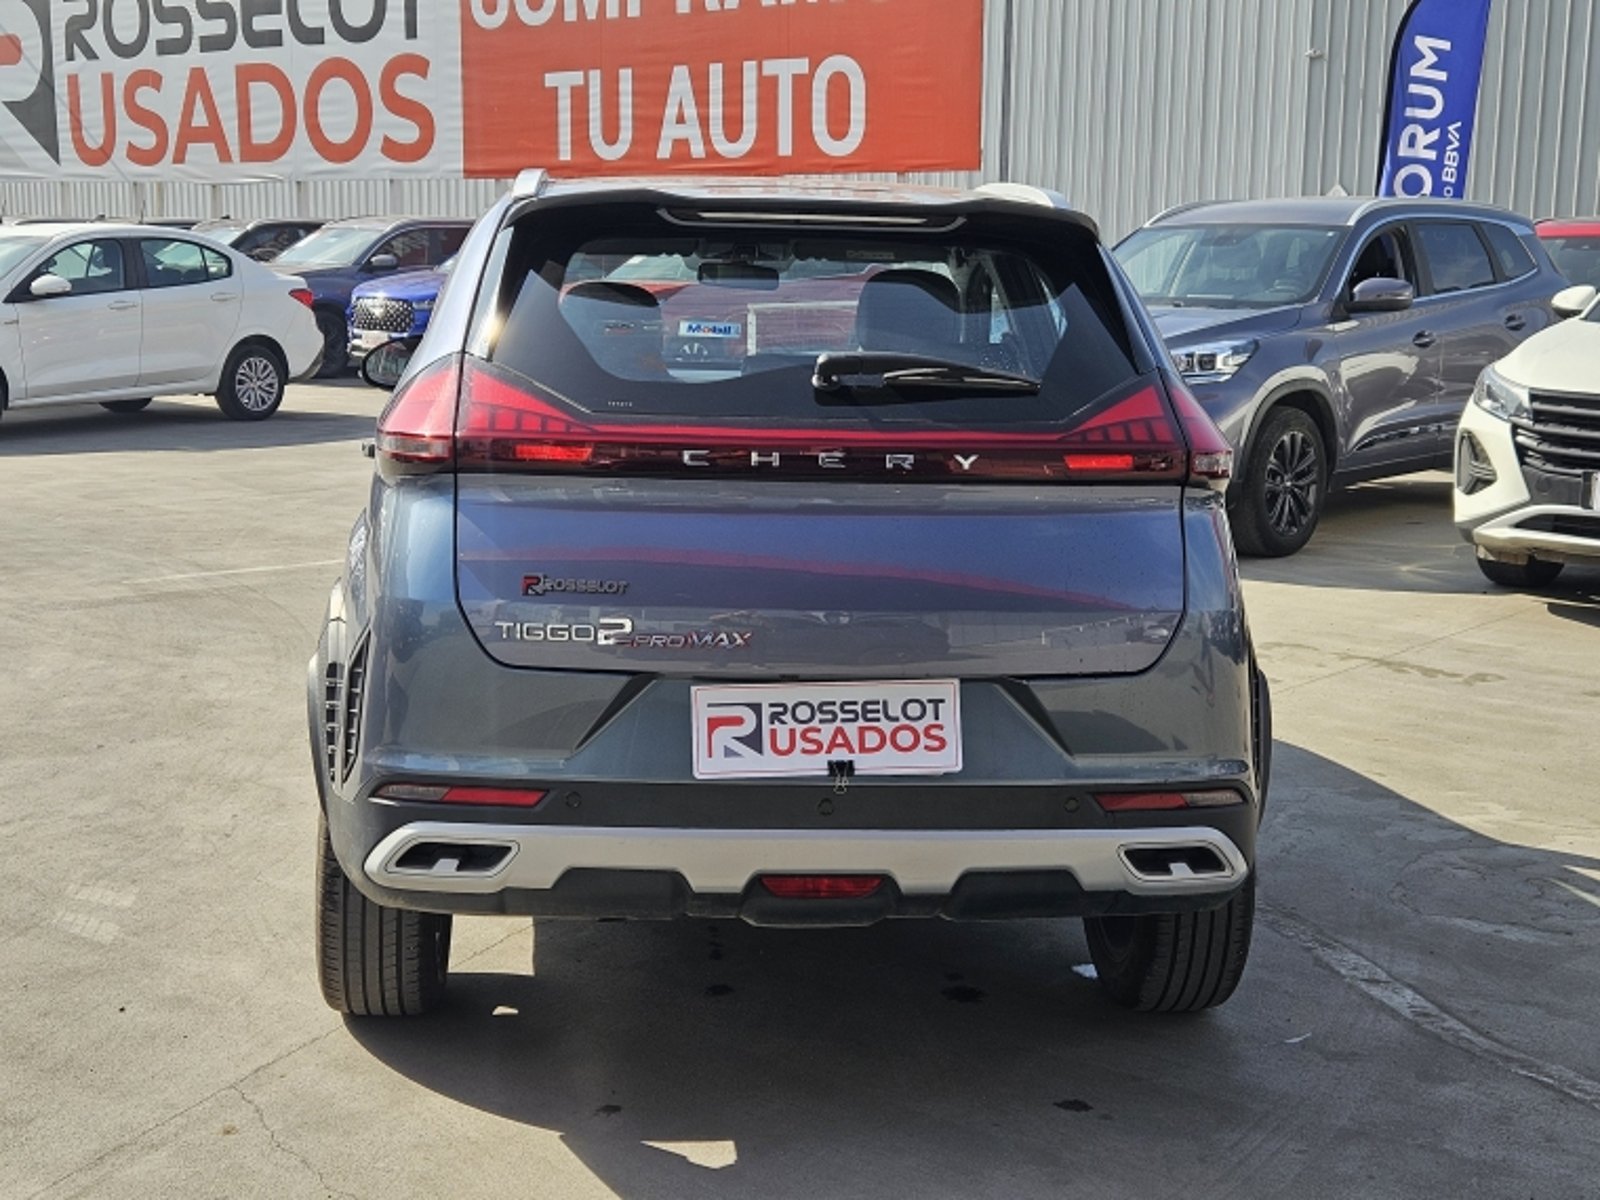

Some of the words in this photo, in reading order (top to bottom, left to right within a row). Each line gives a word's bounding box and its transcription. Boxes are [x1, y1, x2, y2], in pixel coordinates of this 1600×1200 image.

[67, 52, 436, 167] USADOS
[544, 68, 633, 161] TU
[656, 54, 866, 159] AUTO
[1442, 121, 1462, 183] BBVA
[687, 323, 732, 335] Mobil
[682, 450, 979, 470] CHERY
[544, 578, 627, 594] ROSSELOT
[495, 621, 594, 641] TIGGO
[597, 617, 633, 645] 2
[768, 699, 946, 725] ROSSELOT
[769, 724, 948, 757] USADOS
